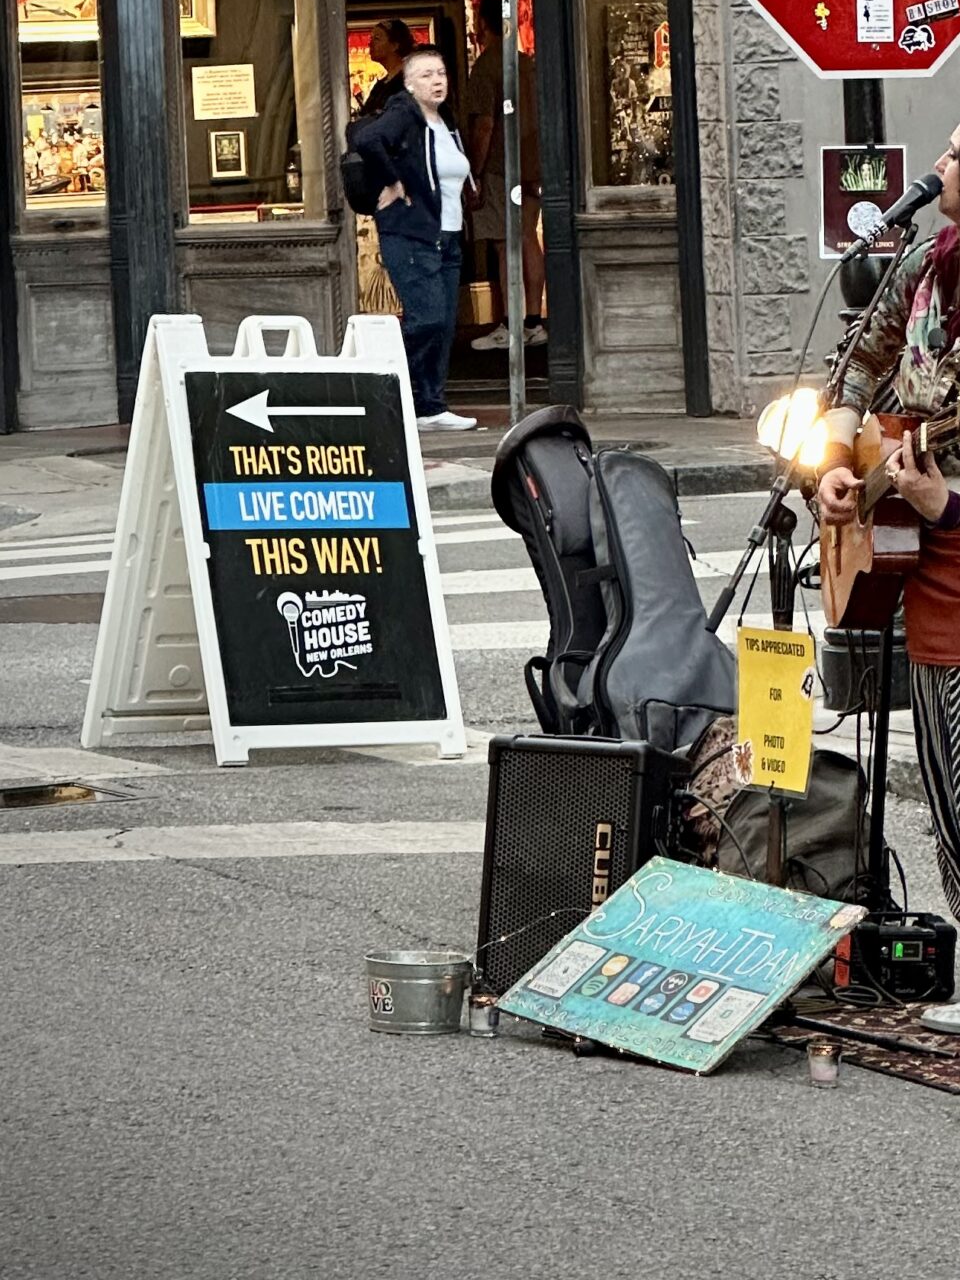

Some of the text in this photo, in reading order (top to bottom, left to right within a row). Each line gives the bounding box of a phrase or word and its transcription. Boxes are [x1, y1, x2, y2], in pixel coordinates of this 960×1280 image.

[229, 446, 374, 477] THAT'S RIGHT,
[238, 491, 375, 521] LIVE COMEDY
[245, 537, 383, 575] THIS WAY!
[301, 602, 367, 627] COMEDY
[304, 621, 371, 650] HOUSE
[745, 638, 805, 657] TIPS APPRECIATED
[306, 643, 373, 663] NEW ORLEANS
[769, 687, 782, 701] FOR
[764, 734, 785, 750] PHOTO
[767, 758, 785, 773] VIDEO
[592, 823, 612, 912] CUB
